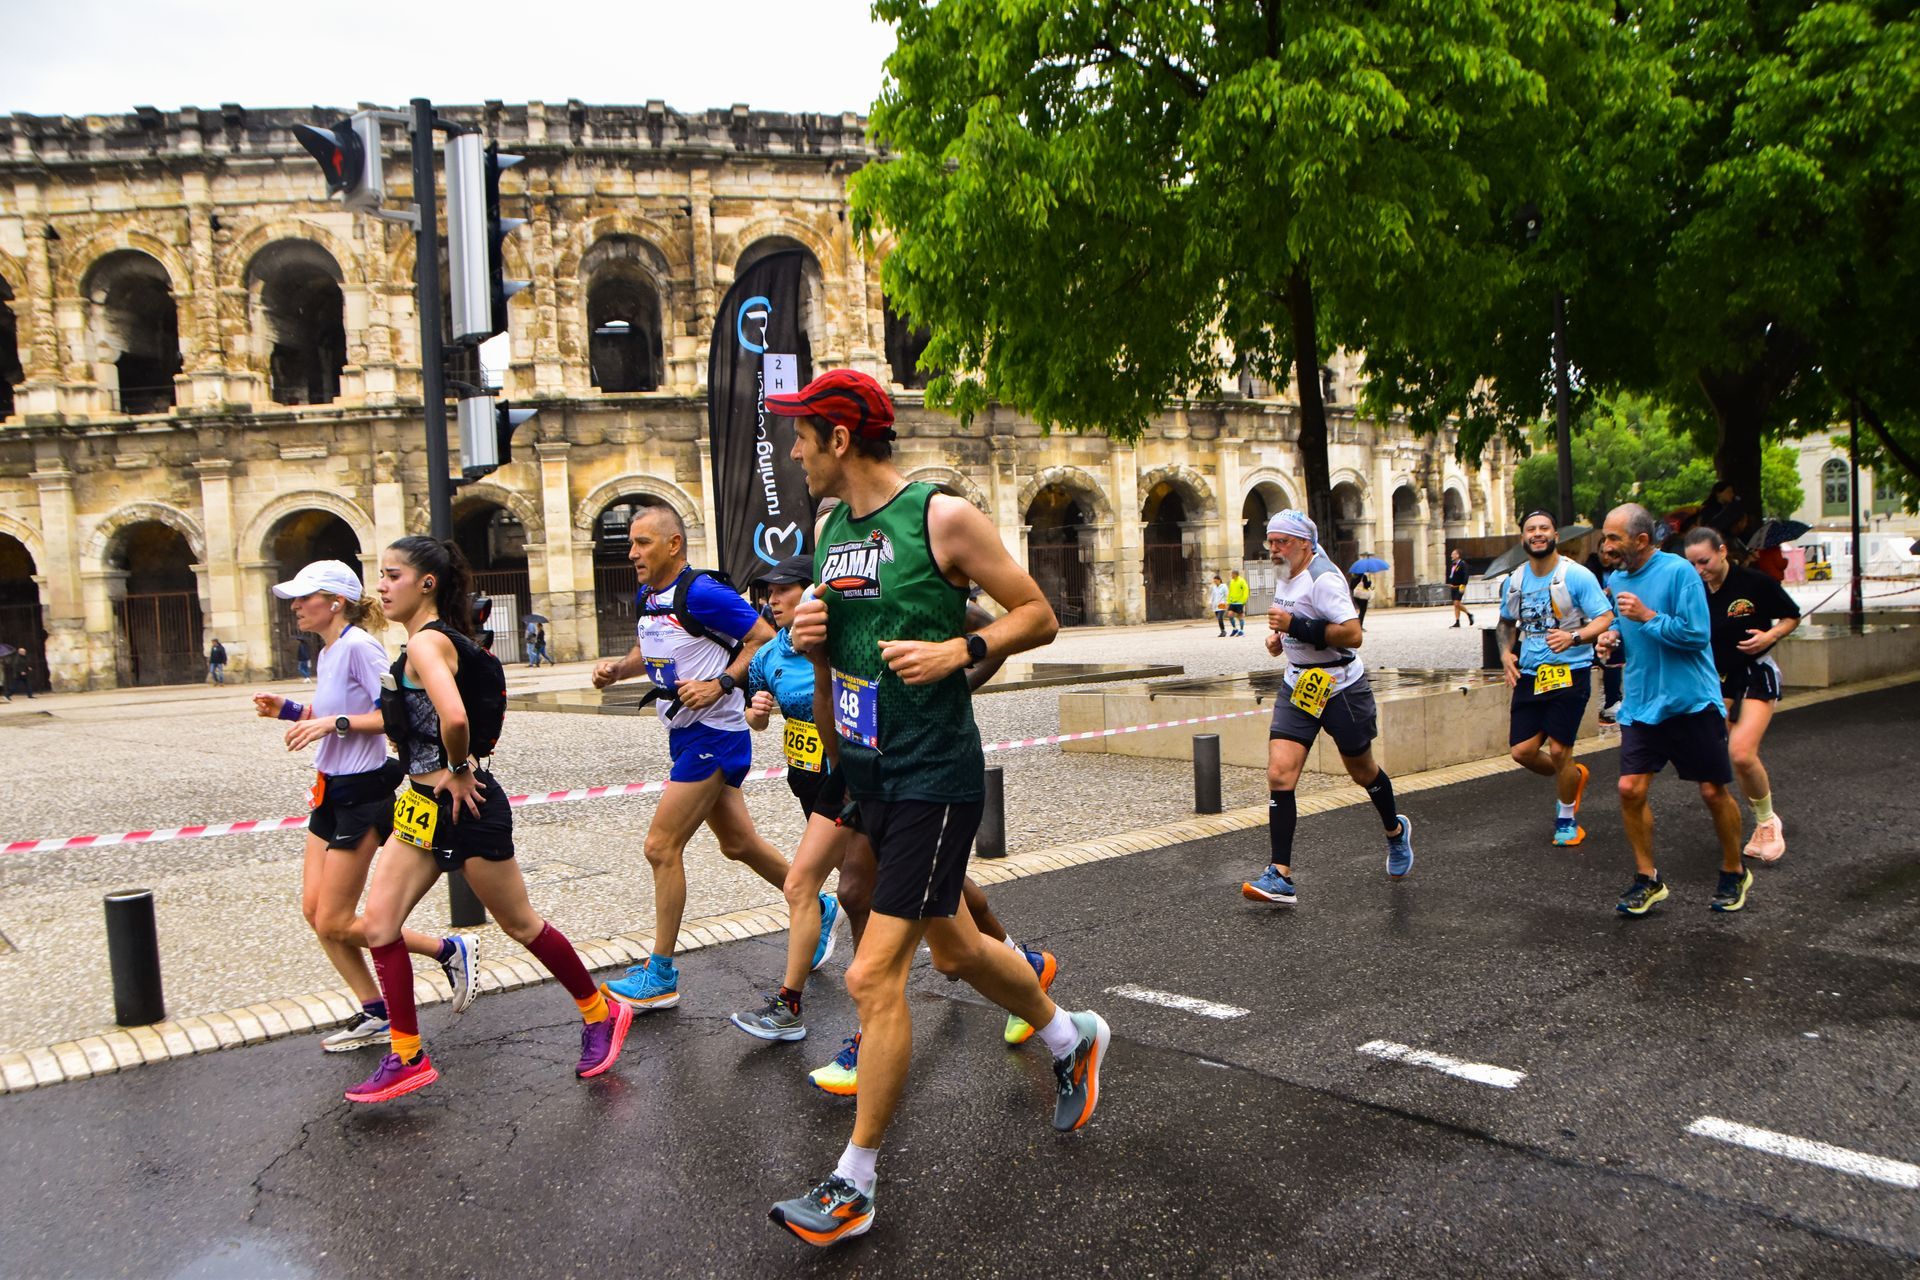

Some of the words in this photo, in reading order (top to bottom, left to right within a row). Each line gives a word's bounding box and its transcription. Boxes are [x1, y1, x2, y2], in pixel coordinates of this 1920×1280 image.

[775, 359, 783, 370] 2
[775, 378, 783, 389] H
[656, 669, 664, 683] 4
[1299, 671, 1324, 710] 1192
[839, 689, 860, 719] 48
[784, 729, 818, 754] 1265
